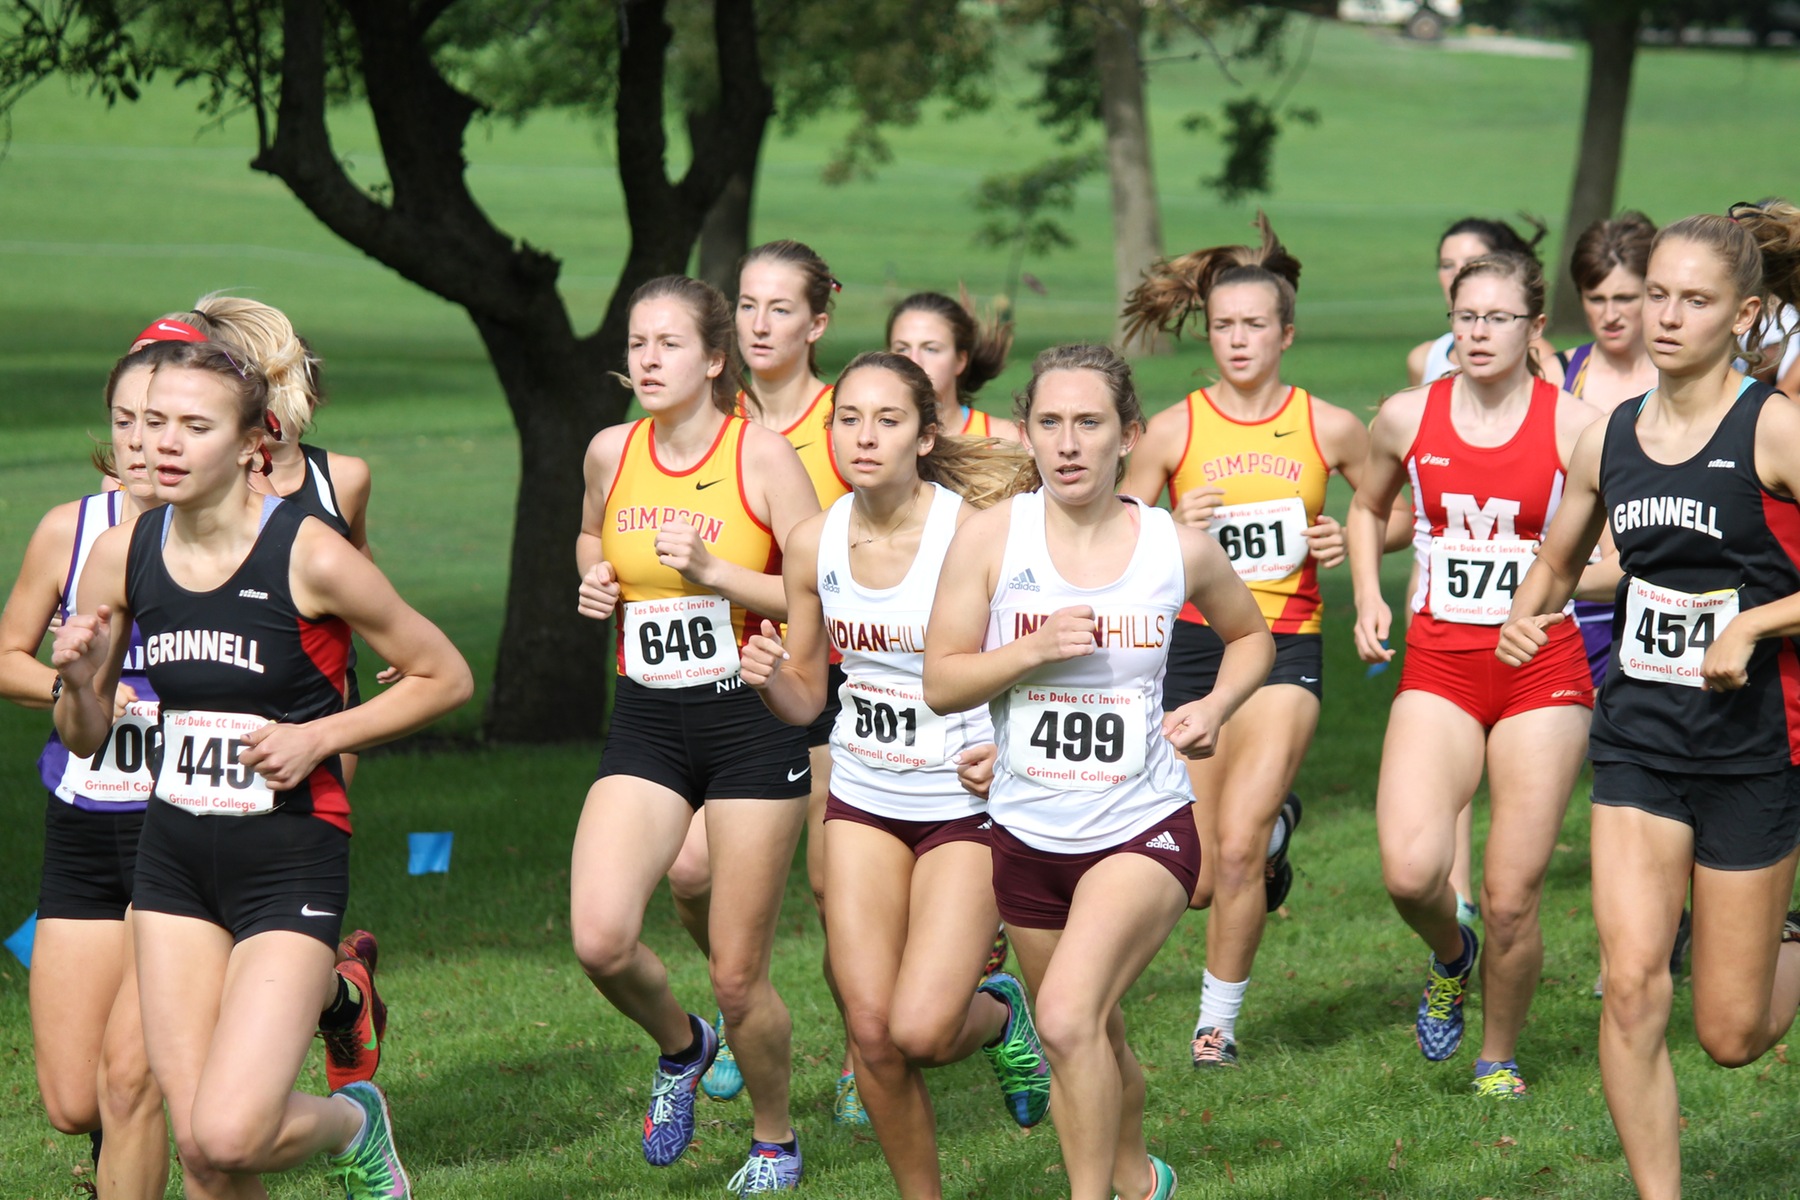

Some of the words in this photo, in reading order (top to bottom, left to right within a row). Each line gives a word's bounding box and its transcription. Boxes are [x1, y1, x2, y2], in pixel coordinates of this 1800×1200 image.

[1203, 453, 1302, 481] SIMPSON
[1440, 491, 1521, 540] M
[1613, 496, 1723, 540] GRINNELL
[1219, 520, 1286, 561] 661
[1460, 543, 1482, 553] Duke
[1485, 544, 1496, 553] CC
[1008, 581, 1041, 592] adidas
[1447, 558, 1518, 600] 574
[1636, 585, 1648, 598] Les
[1650, 590, 1672, 605] Duke
[1676, 598, 1688, 608] CC
[634, 606, 647, 616] Les
[649, 604, 670, 615] Duke
[673, 602, 685, 612] CC
[687, 599, 715, 610] Invite
[1443, 603, 1483, 615] Grinnell
[1486, 605, 1511, 616] Colle
[639, 615, 717, 666] 646
[1635, 607, 1715, 658] 454
[146, 629, 265, 674] GRINNELL
[642, 669, 682, 683] Grinnell
[686, 665, 726, 679] College
[1630, 658, 1673, 675] Grinnell
[1676, 666, 1704, 677] Coll
[716, 674, 747, 694] NIK
[846, 680, 859, 690] Les
[861, 683, 883, 694] Duke
[886, 688, 897, 697] CC
[1028, 691, 1045, 701] Les
[1050, 692, 1077, 704] Duke
[1082, 693, 1095, 704] CC
[1099, 693, 1131, 705] Invite
[131, 706, 143, 717] CC
[851, 695, 917, 747] 501
[175, 715, 186, 726] Les
[188, 717, 211, 728] Duke
[215, 718, 228, 729] CC
[1030, 710, 1125, 763] 499
[177, 735, 255, 790] 445
[847, 743, 883, 760] Grinnell
[886, 752, 927, 768] College
[85, 779, 129, 791] Grinnell
[1026, 766, 1076, 780] Grinnell
[1081, 770, 1127, 785] College
[169, 793, 208, 807] Grinnell
[212, 798, 257, 812] College
[1145, 841, 1180, 852] adidas
